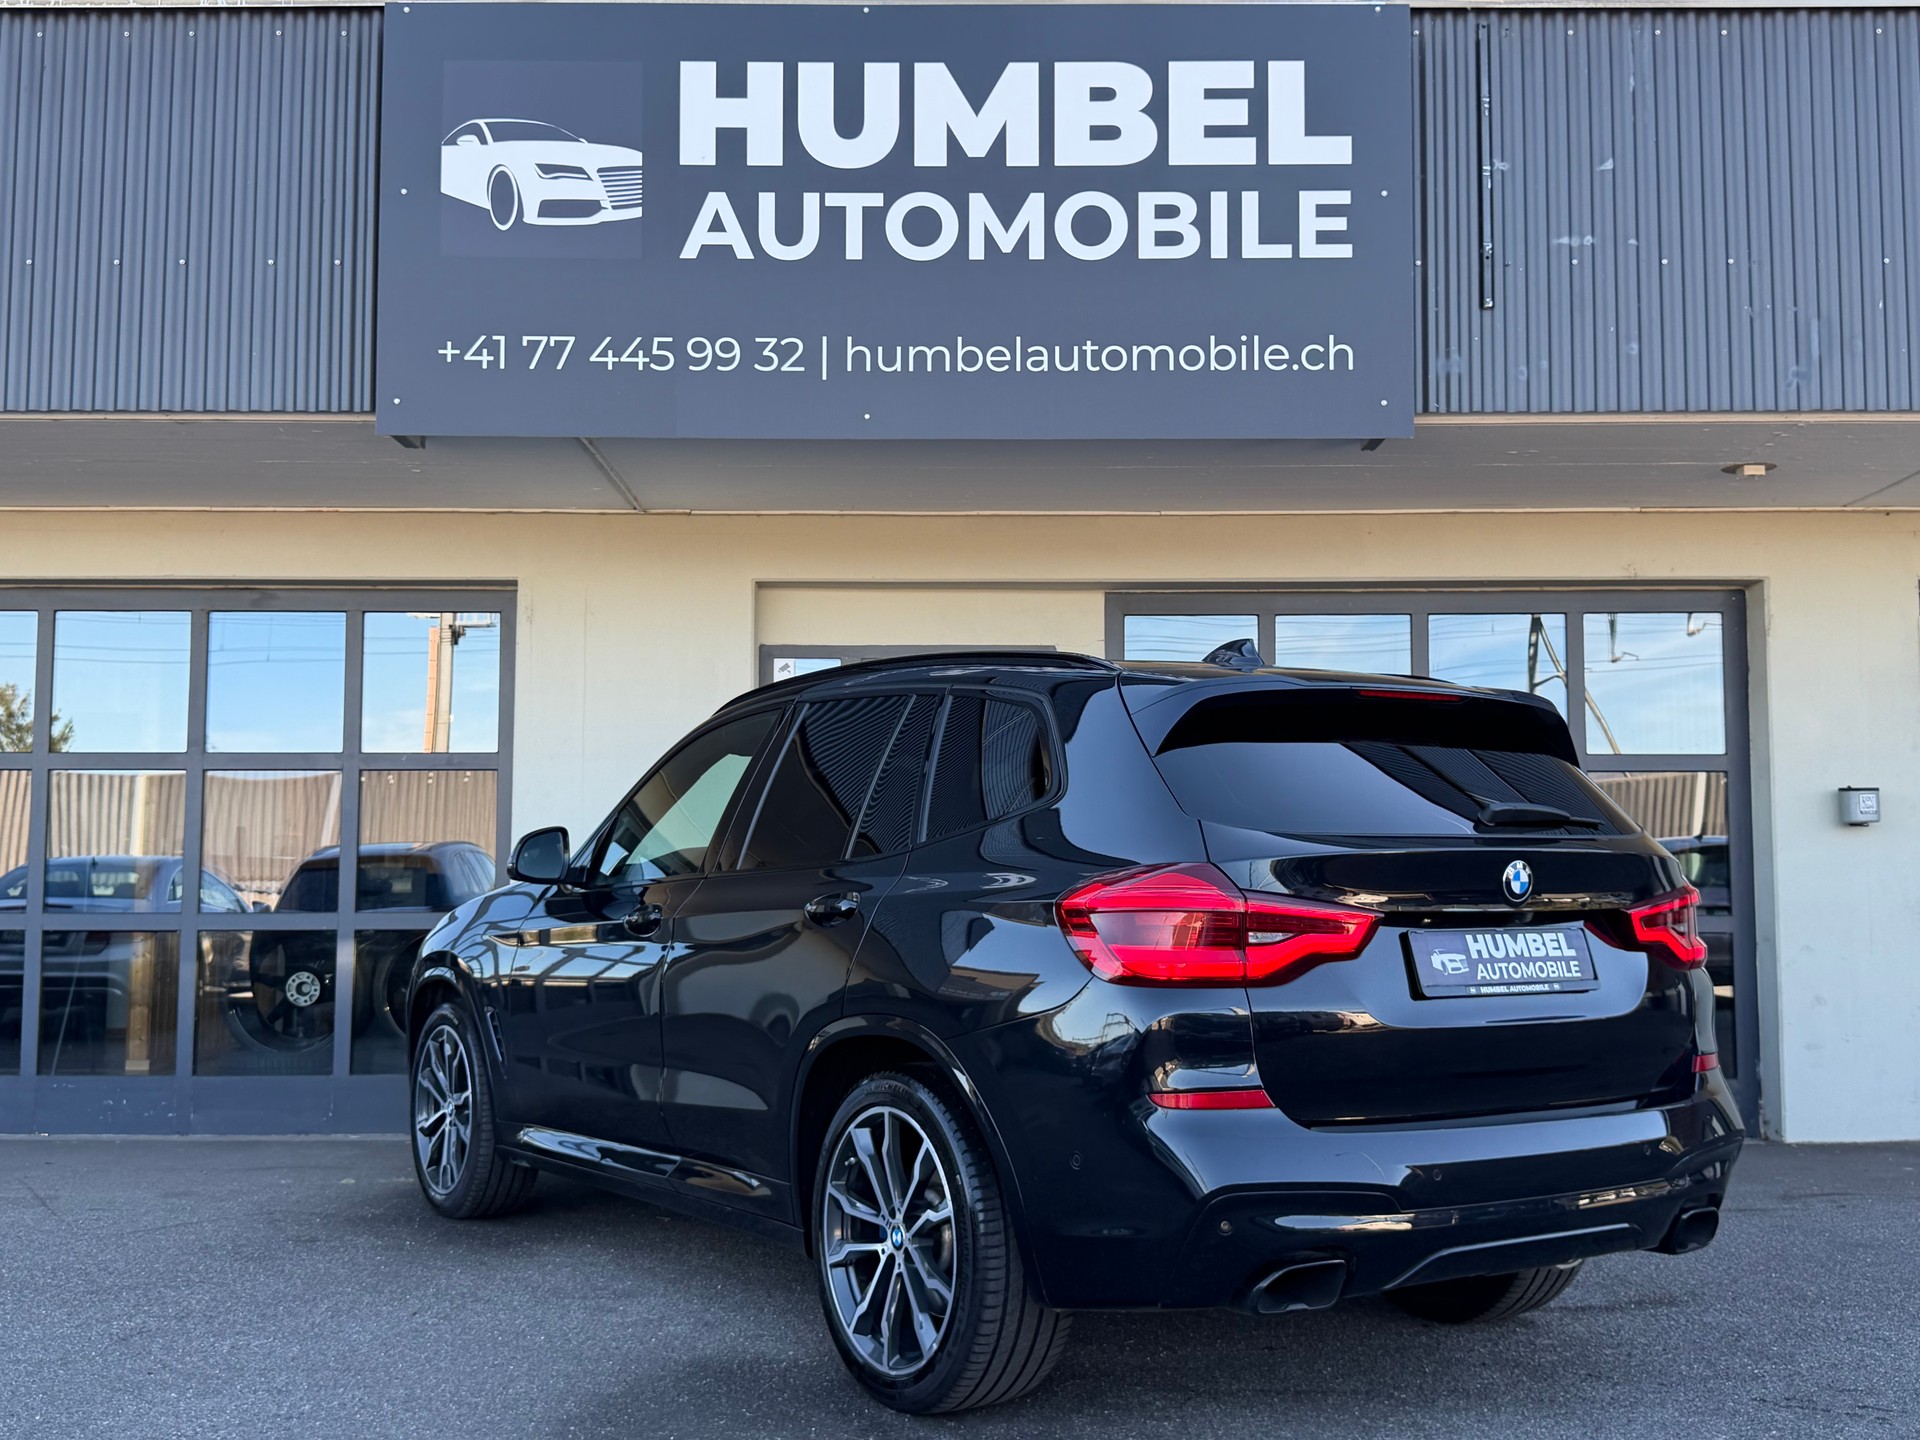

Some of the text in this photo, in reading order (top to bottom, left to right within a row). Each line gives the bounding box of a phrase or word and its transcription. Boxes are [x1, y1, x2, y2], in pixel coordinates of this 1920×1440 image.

[679, 60, 1353, 169] HUMBEL
[679, 190, 1353, 262] AUTOMOBILE
[437, 335, 506, 370] +41
[522, 335, 576, 370] 77
[589, 336, 675, 371] 445
[686, 336, 741, 372] 99
[753, 337, 805, 372] 32
[846, 334, 1354, 373] humbelautomobile.ch
[1465, 932, 1577, 959] HUMBEL
[1477, 961, 1582, 981] AUTOMOBILE
[1480, 983, 1550, 994] HUMBEL AUTOMOBILE
